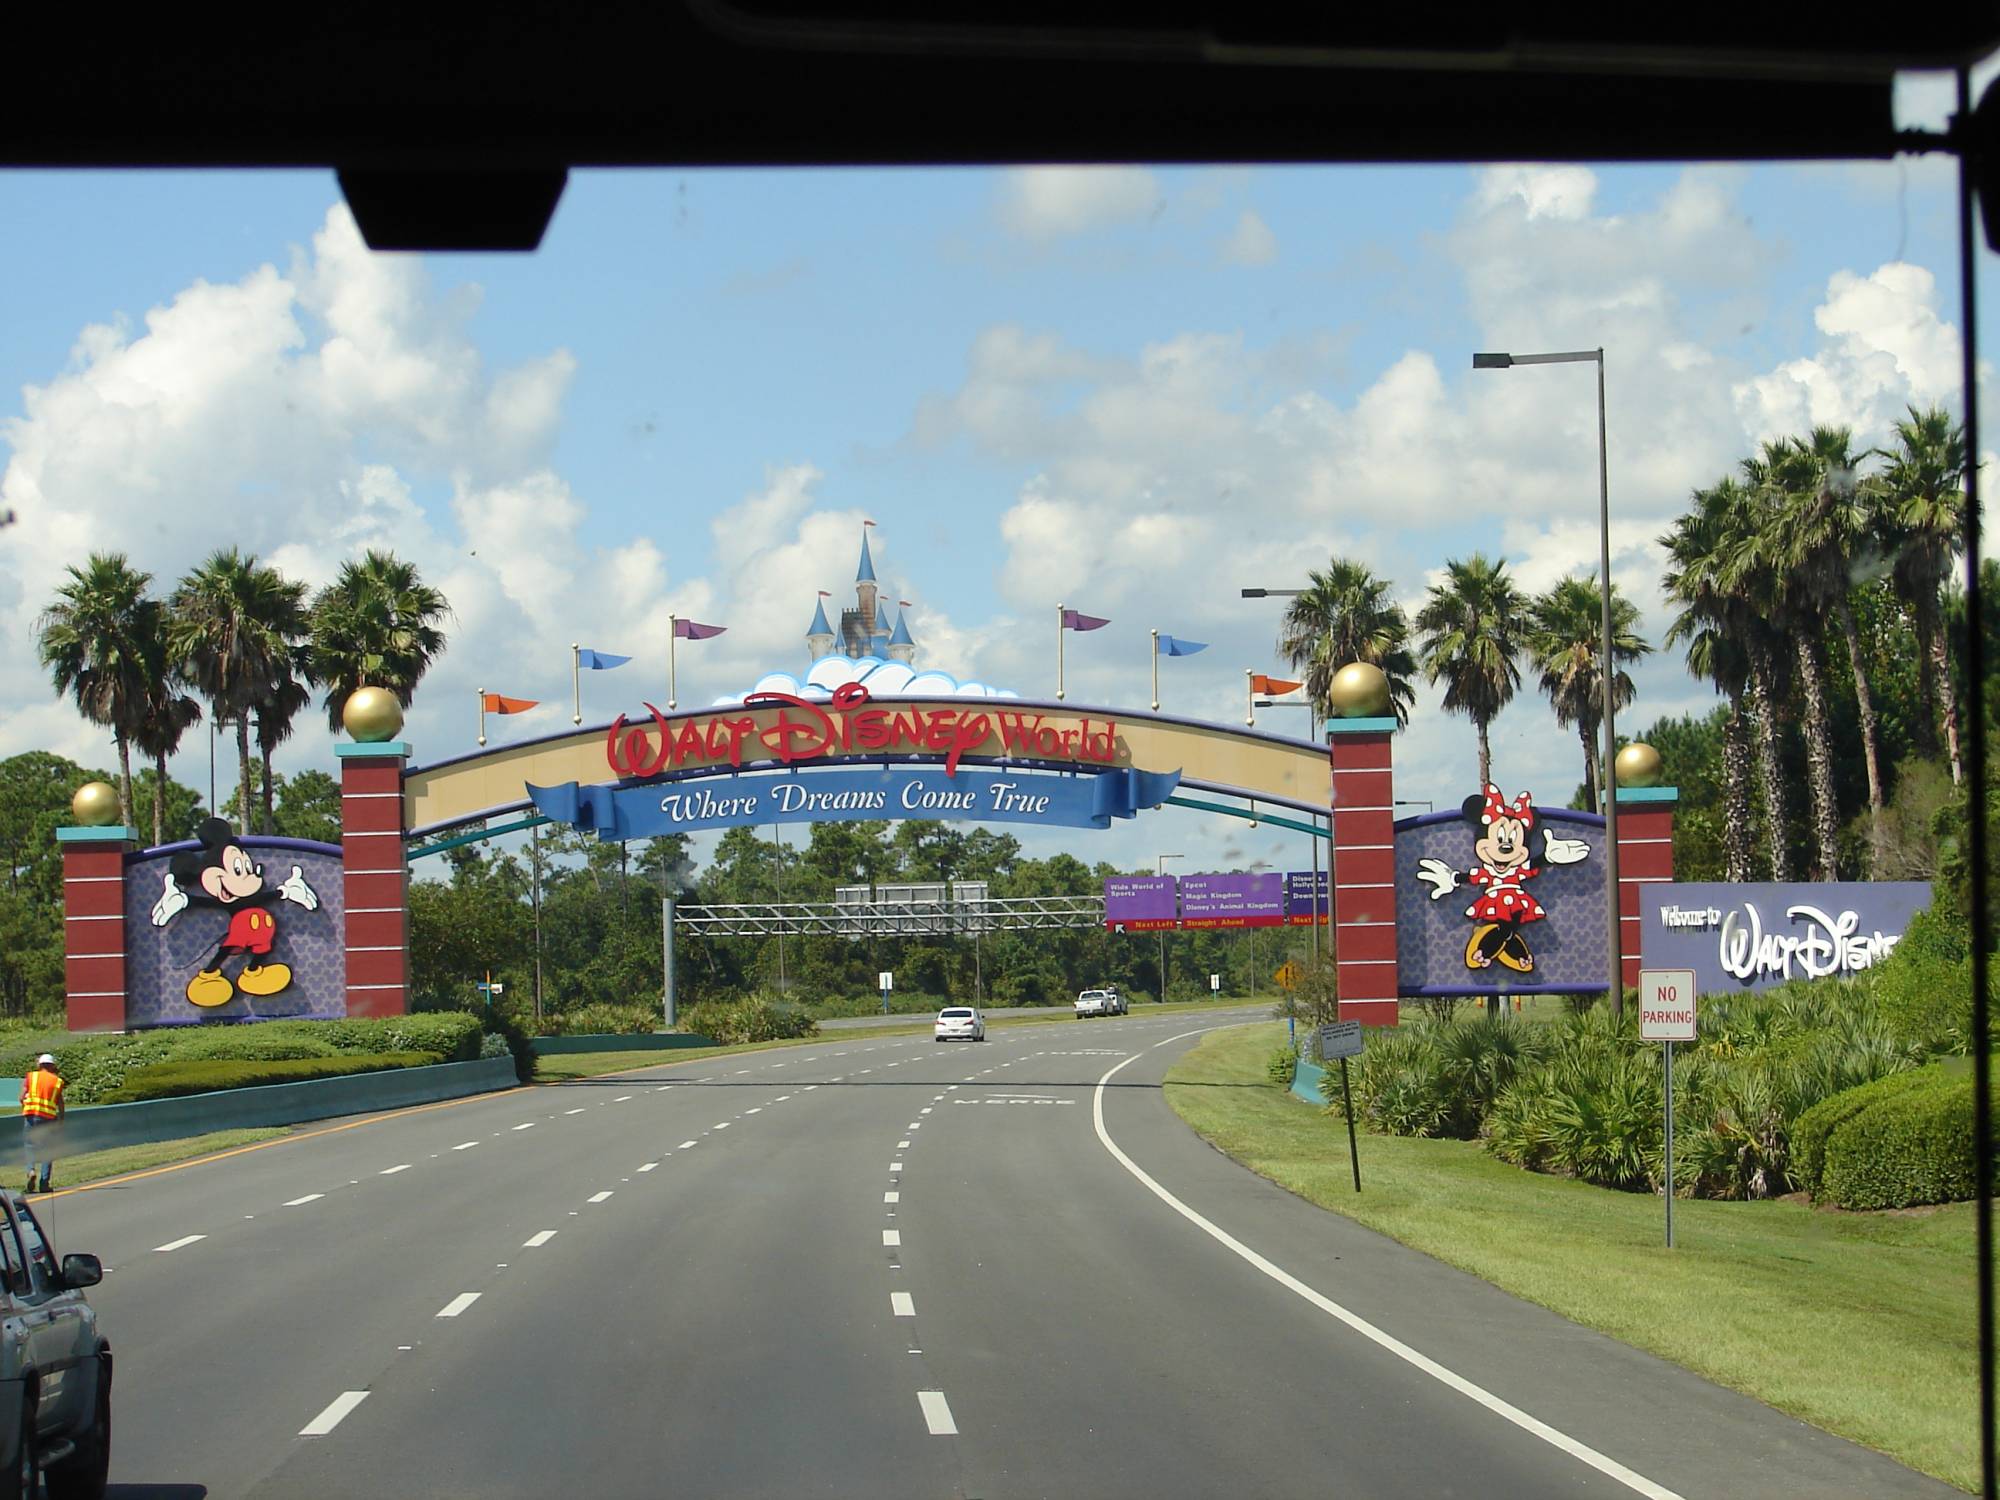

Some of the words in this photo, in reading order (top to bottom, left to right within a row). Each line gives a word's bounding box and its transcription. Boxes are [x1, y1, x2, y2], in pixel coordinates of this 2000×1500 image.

[993, 710, 1116, 762] World
[661, 791, 757, 823] Where
[771, 784, 886, 814] Dreams
[900, 781, 976, 811] Come
[989, 783, 1050, 814] True
[1210, 892, 1242, 900] Kingdom
[1186, 903, 1216, 911] Disney's
[1247, 902, 1278, 910] Kingdom
[1186, 919, 1217, 927] Straight
[1221, 918, 1245, 926] Ahead
[1660, 905, 1706, 926] Welcome
[1657, 986, 1677, 1002] NO
[1642, 1011, 1693, 1024] PARKING
